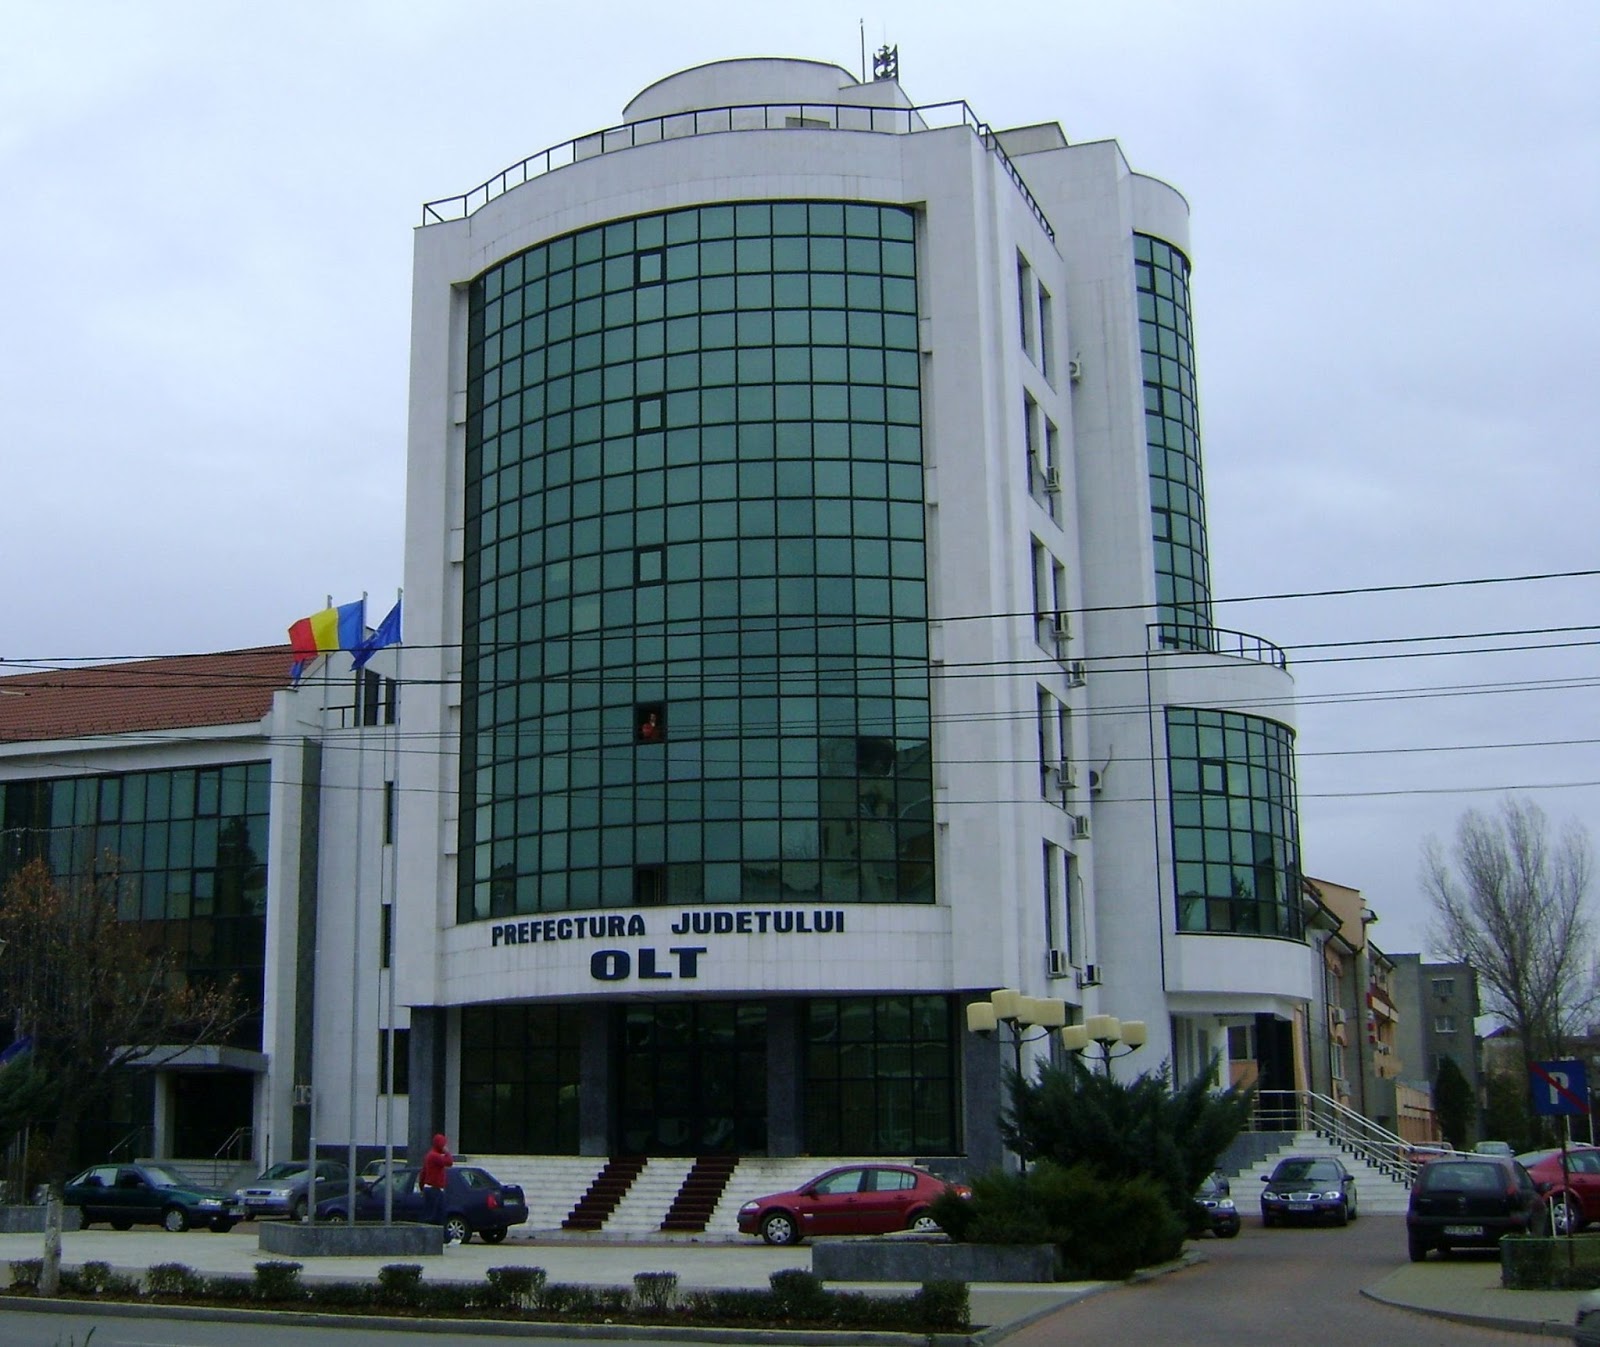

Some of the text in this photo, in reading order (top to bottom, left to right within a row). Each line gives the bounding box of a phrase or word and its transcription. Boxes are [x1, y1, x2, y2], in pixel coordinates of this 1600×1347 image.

[492, 911, 845, 947] PREFECTURA JUDETULUI
[590, 947, 707, 981] OLT
[1548, 1071, 1569, 1105] P
